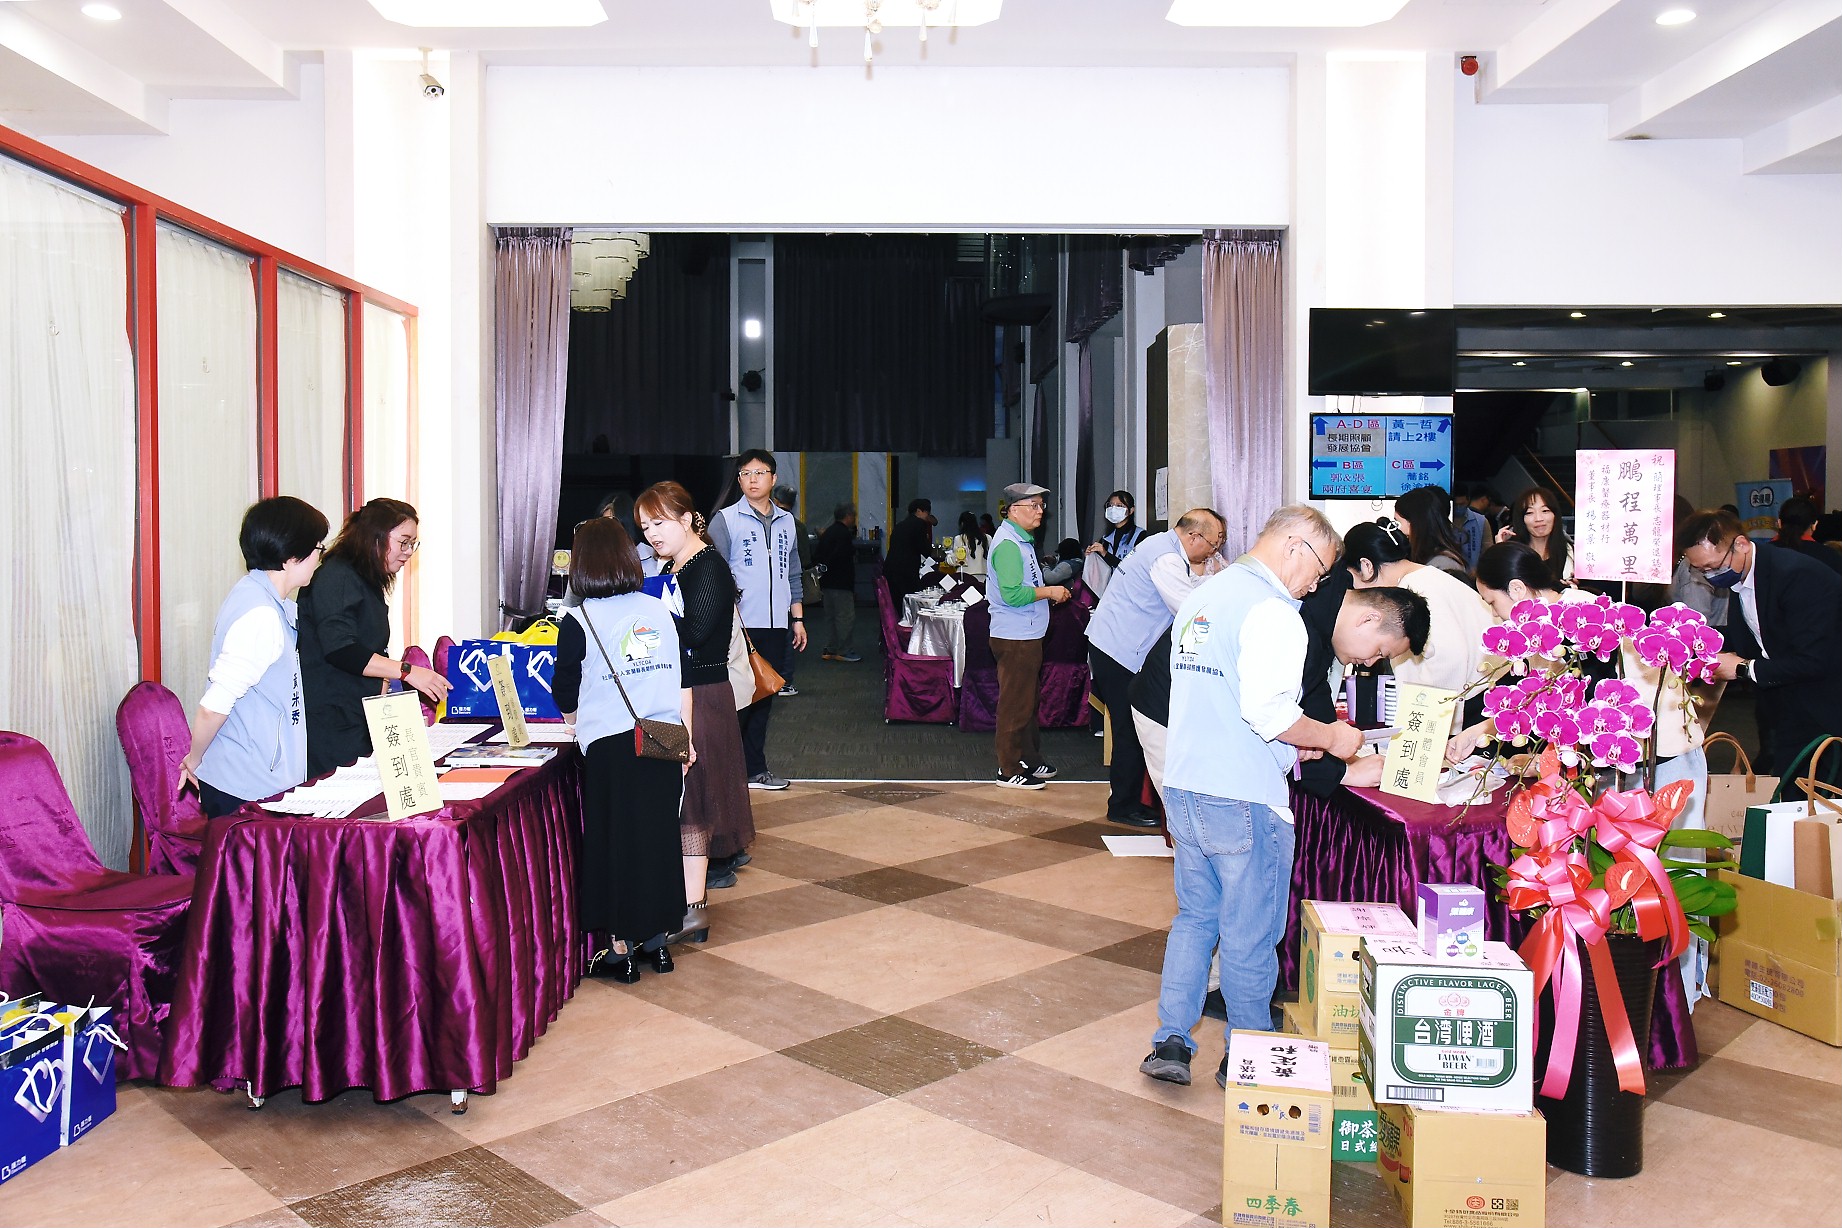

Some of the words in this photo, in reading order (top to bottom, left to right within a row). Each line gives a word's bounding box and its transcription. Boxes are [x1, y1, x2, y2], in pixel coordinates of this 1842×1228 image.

[1336, 419, 1363, 429] A-D
[1367, 419, 1380, 429] 區
[1392, 419, 1433, 430] 黃一哲
[1388, 432, 1437, 442] 請上2樓
[1327, 443, 1372, 453] 發展協會
[1651, 454, 1664, 466] 祝
[1322, 484, 1373, 494] 兩府喜宴
[1617, 458, 1643, 575] 鵬程萬里
[1393, 710, 1424, 790] 簽到處
[384, 724, 416, 810] 簽到處
[1396, 978, 1434, 1015] DISTINCTIVE
[1438, 979, 1473, 988] FLAVOR
[1477, 981, 1508, 994] LAGER
[1438, 1053, 1471, 1062] TAIWAN
[1442, 1061, 1468, 1070] BEER
[1338, 1119, 1378, 1139] 御茶
[1246, 1195, 1303, 1217] 四季春
